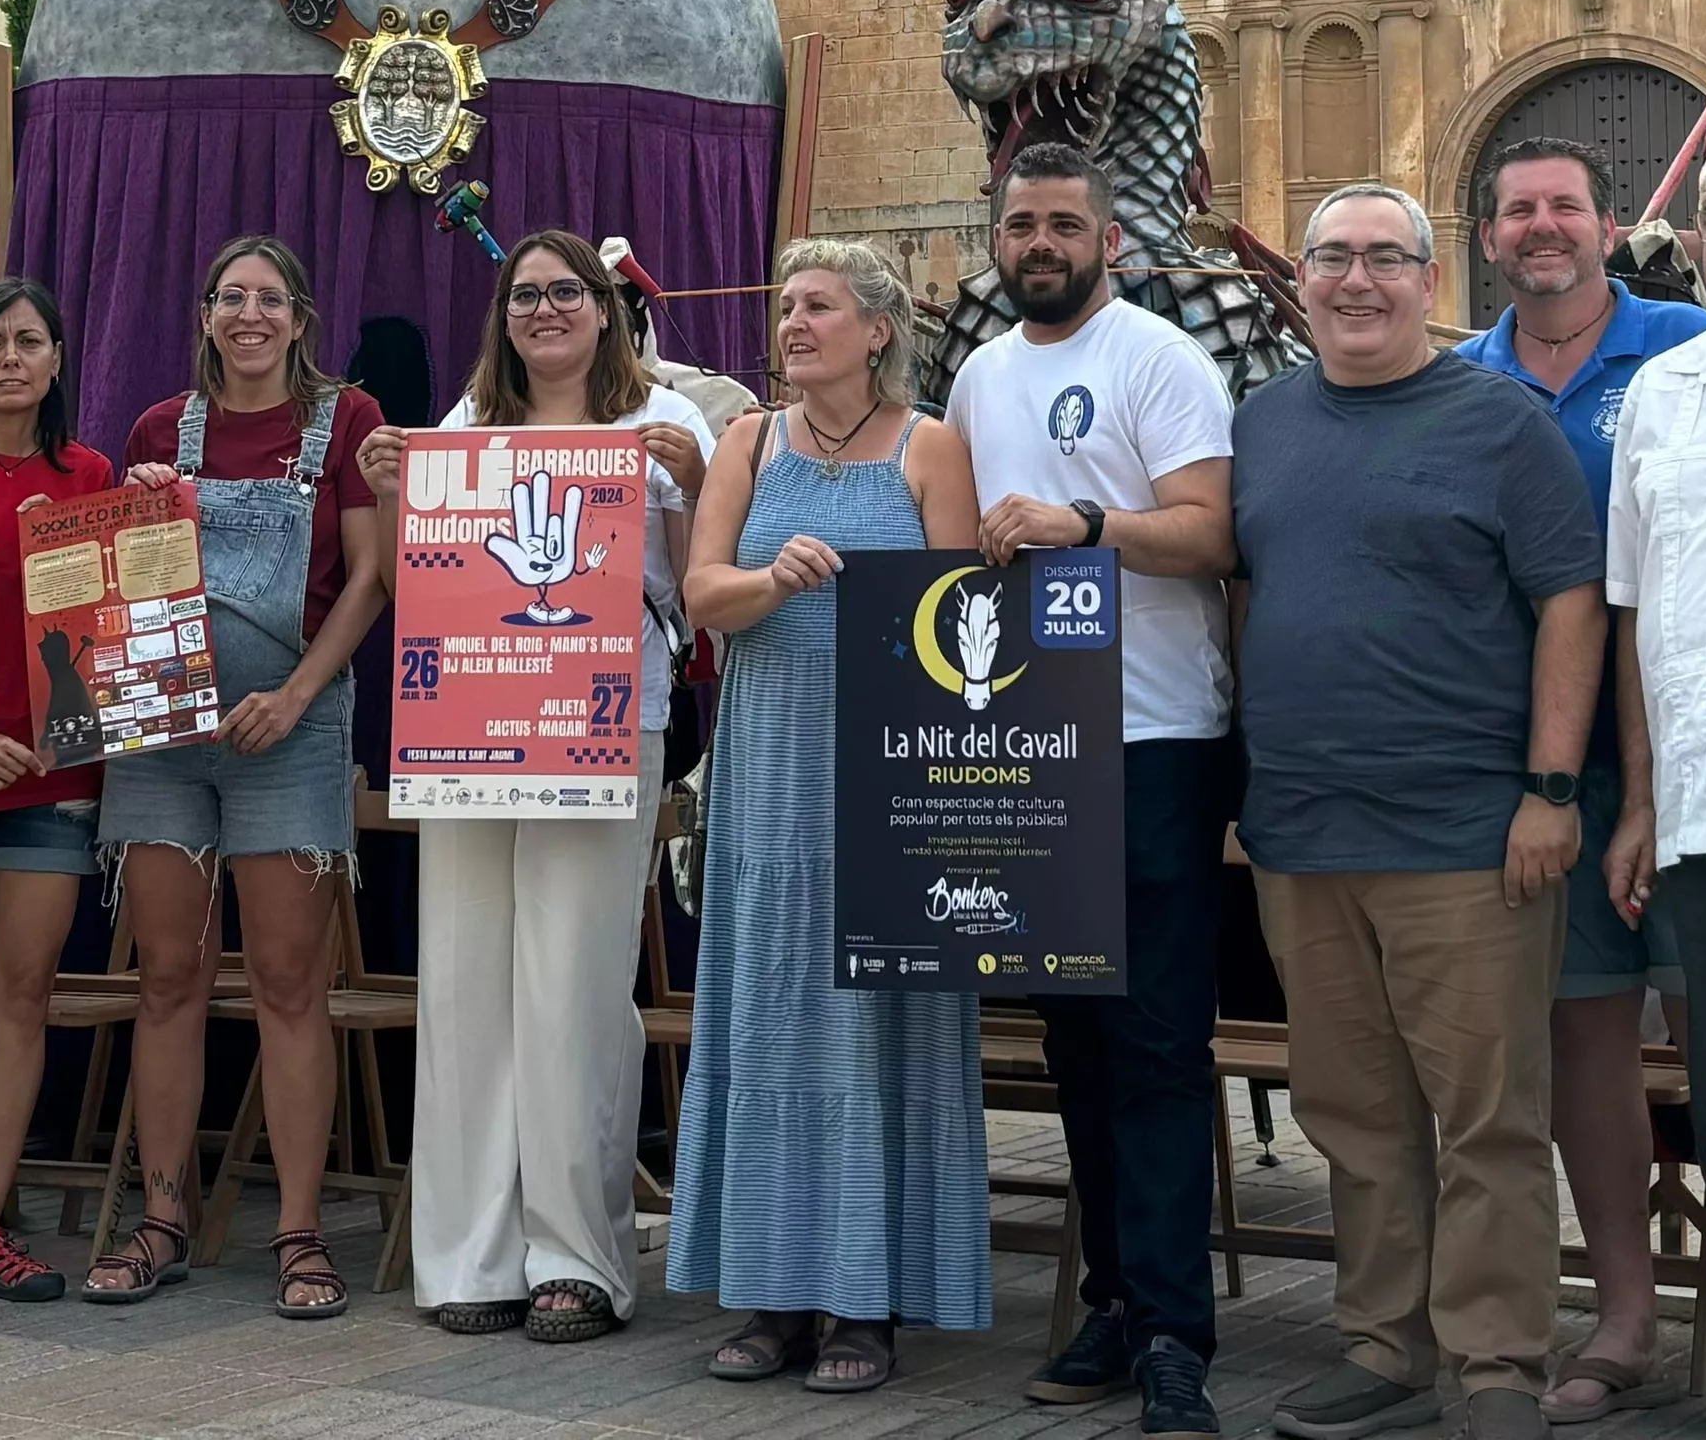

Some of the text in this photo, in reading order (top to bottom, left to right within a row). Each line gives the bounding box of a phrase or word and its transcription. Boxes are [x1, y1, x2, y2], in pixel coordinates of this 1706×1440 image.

[406, 436, 639, 512] ULÉ BARRAQUES
[590, 487, 623, 504] 2024
[31, 515, 79, 537] XXXII
[84, 493, 182, 524] CORREFOC
[404, 513, 512, 545] Riudoms
[1044, 566, 1102, 577] DISSABTE
[1045, 581, 1101, 616] 20
[1044, 621, 1106, 635] JULIOL
[444, 636, 634, 653] MIQUEL DEL ROIG MANO'S ROCK
[401, 650, 439, 689] 26
[443, 653, 553, 674] DJ ALEIX BALLESTÉ
[592, 673, 632, 684] DISSABTE
[540, 699, 587, 716] JULIETA
[591, 685, 632, 725] 27
[485, 720, 587, 737] CACTUS MAGARI
[884, 723, 1077, 759] La Nit del Cavall
[407, 749, 515, 761] FESTA MAJOR DE SANT JAUME
[928, 766, 1031, 784] RIUDOMS
[892, 796, 1065, 812] Gran espectacle de cultura
[890, 812, 939, 827] popular
[942, 815, 964, 827] per
[967, 814, 992, 826] tots
[995, 813, 1013, 826] els
[925, 877, 1009, 922] Bonkers
